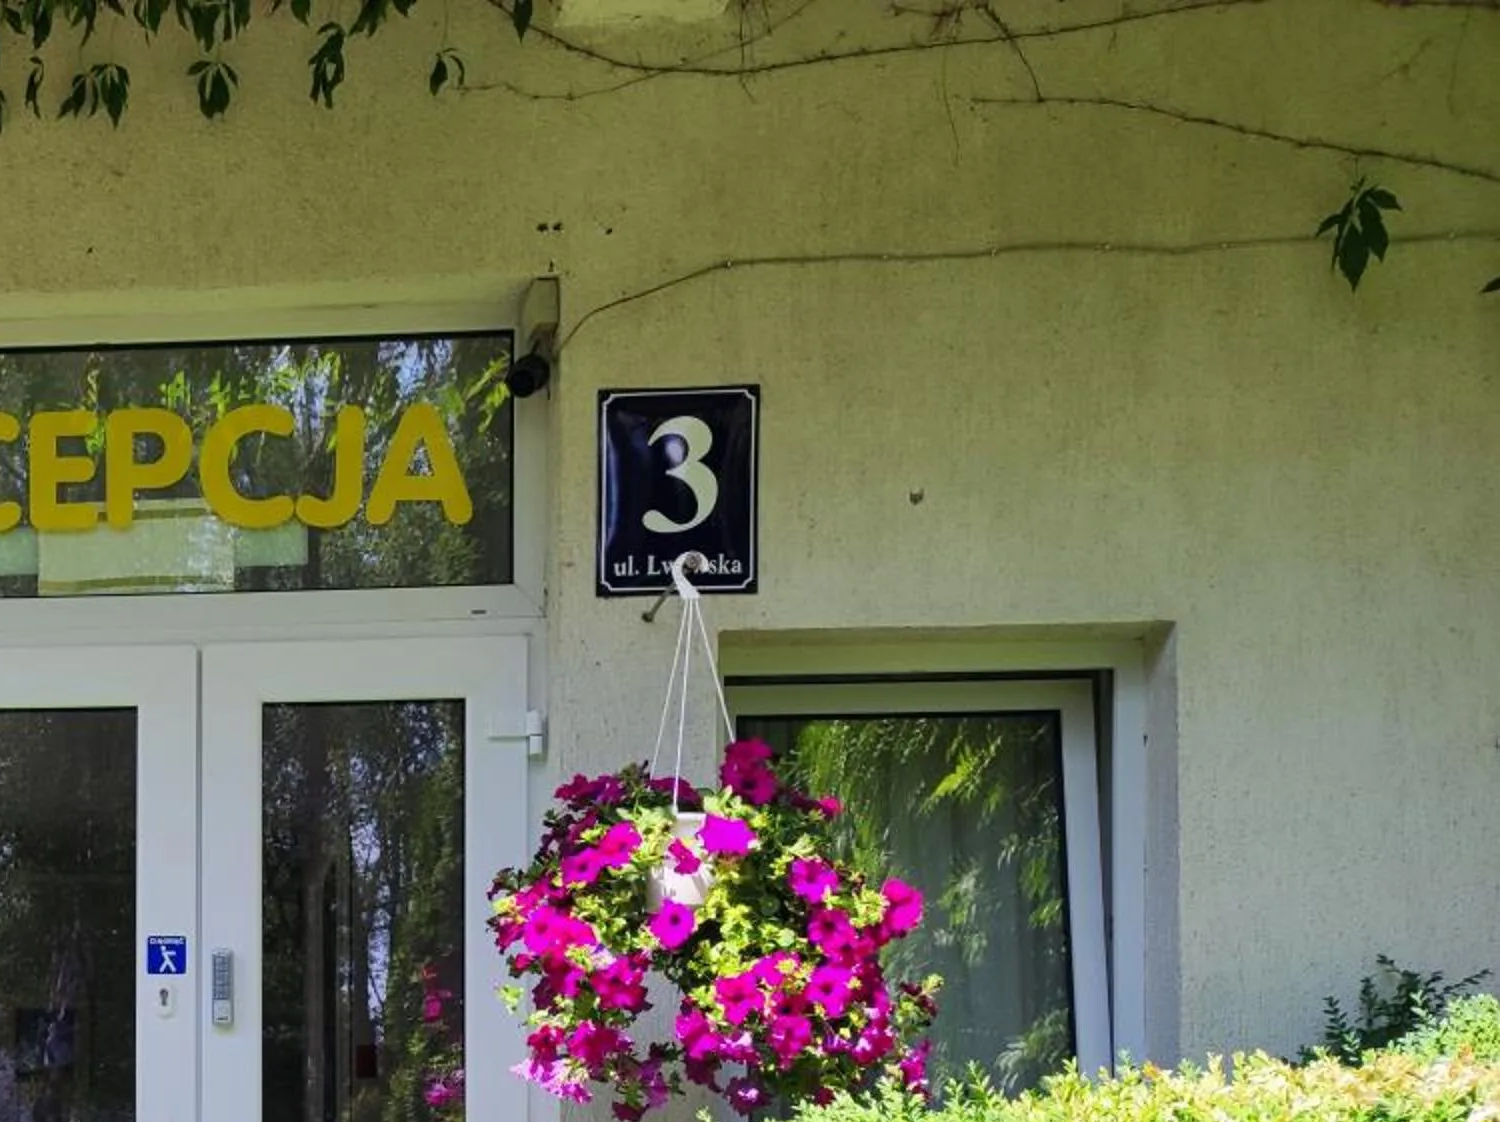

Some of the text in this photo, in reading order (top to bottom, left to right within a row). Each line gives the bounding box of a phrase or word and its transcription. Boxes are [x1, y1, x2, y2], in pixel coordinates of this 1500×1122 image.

[642, 415, 719, 533] 3
[613, 553, 743, 577] ul. Lwska
